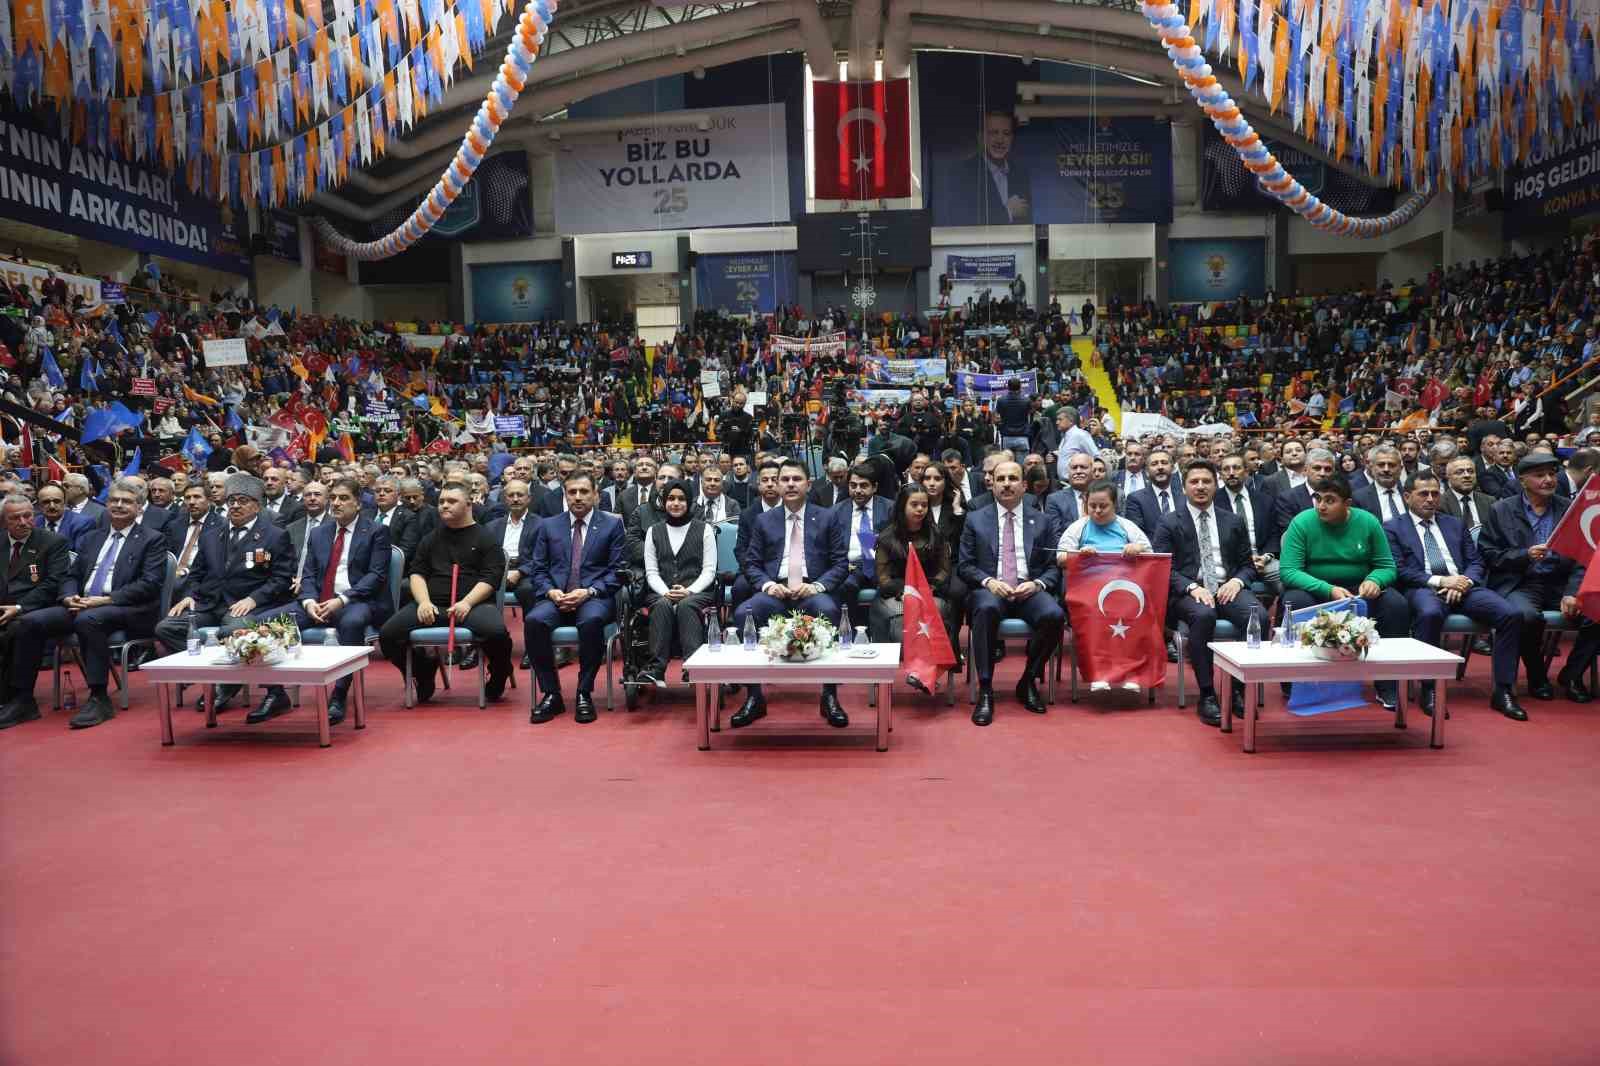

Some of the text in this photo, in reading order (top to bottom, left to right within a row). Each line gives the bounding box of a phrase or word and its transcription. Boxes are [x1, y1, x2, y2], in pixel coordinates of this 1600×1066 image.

[626, 137, 710, 163] BİZ BU
[599, 159, 742, 188] YOLLARDA
[1513, 172, 1545, 200] HOŞ
[652, 187, 689, 213] 25
[69, 188, 209, 252] ARKASINDA!
[615, 254, 637, 265] 14:26
